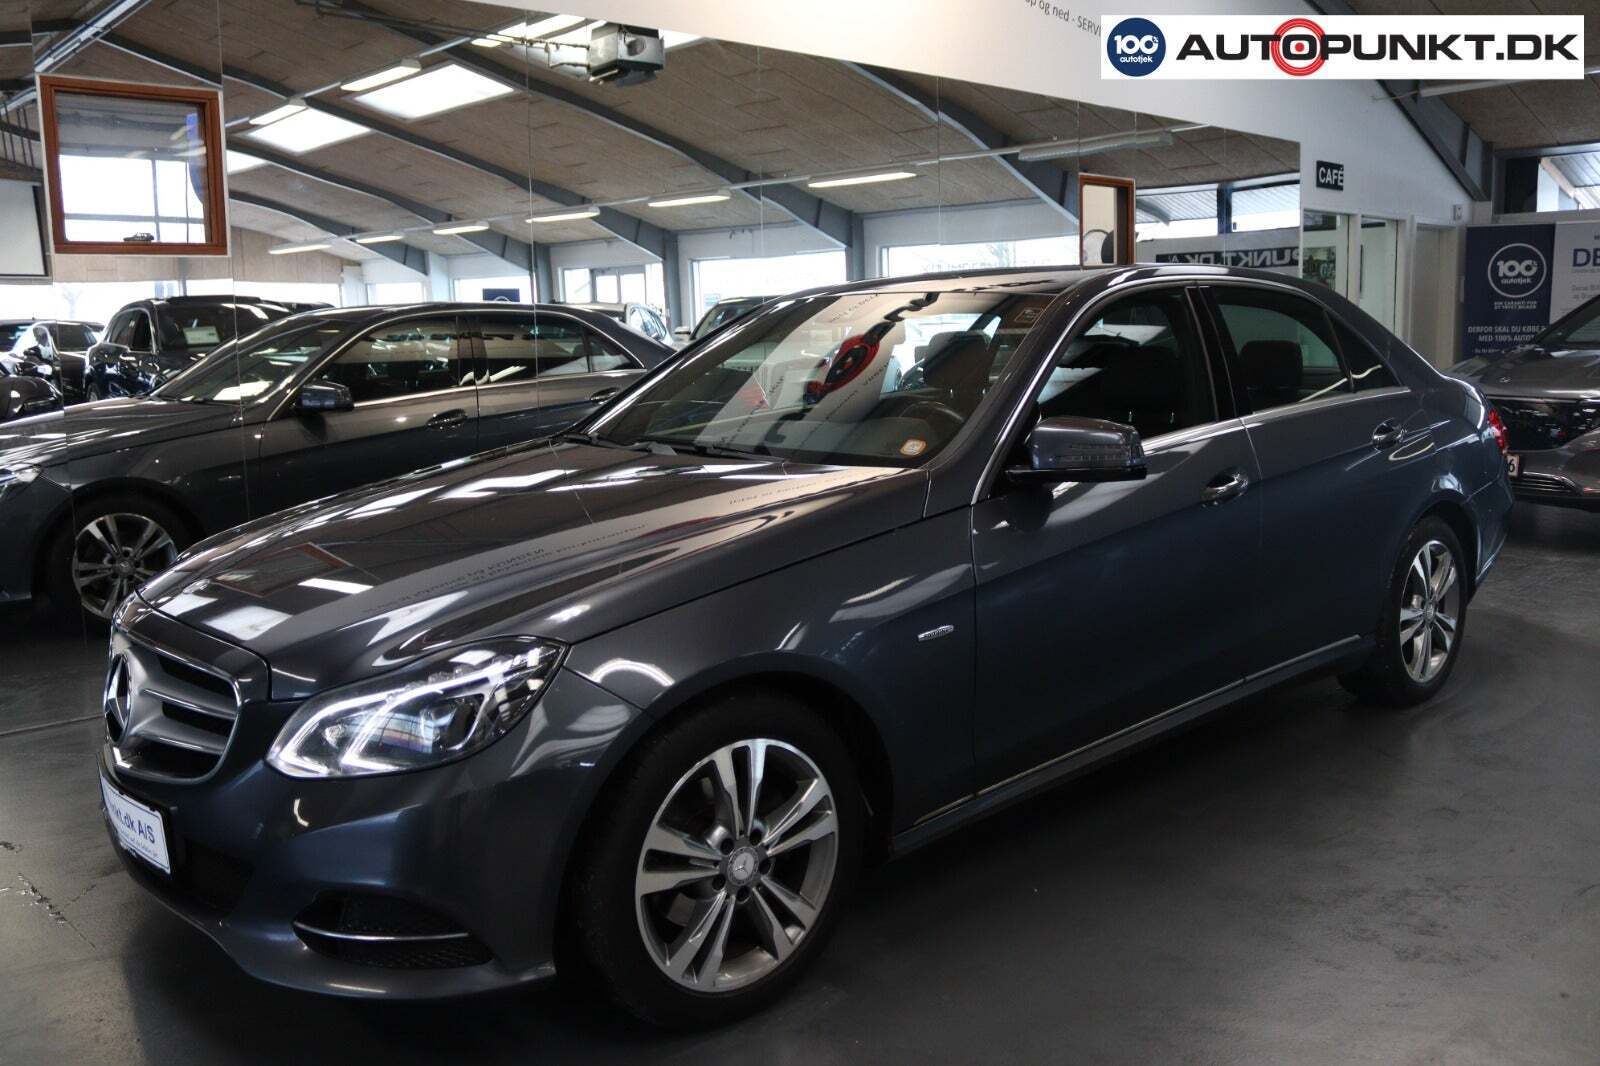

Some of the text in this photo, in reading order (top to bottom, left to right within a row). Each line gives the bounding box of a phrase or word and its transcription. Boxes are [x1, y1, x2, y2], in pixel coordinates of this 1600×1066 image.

[1038, 0, 1050, 15] og
[1052, 6, 1070, 22] ned
[1318, 167, 1344, 186] CAFÉ
[1507, 458, 1516, 473] 6
[138, 819, 156, 845] A/S
